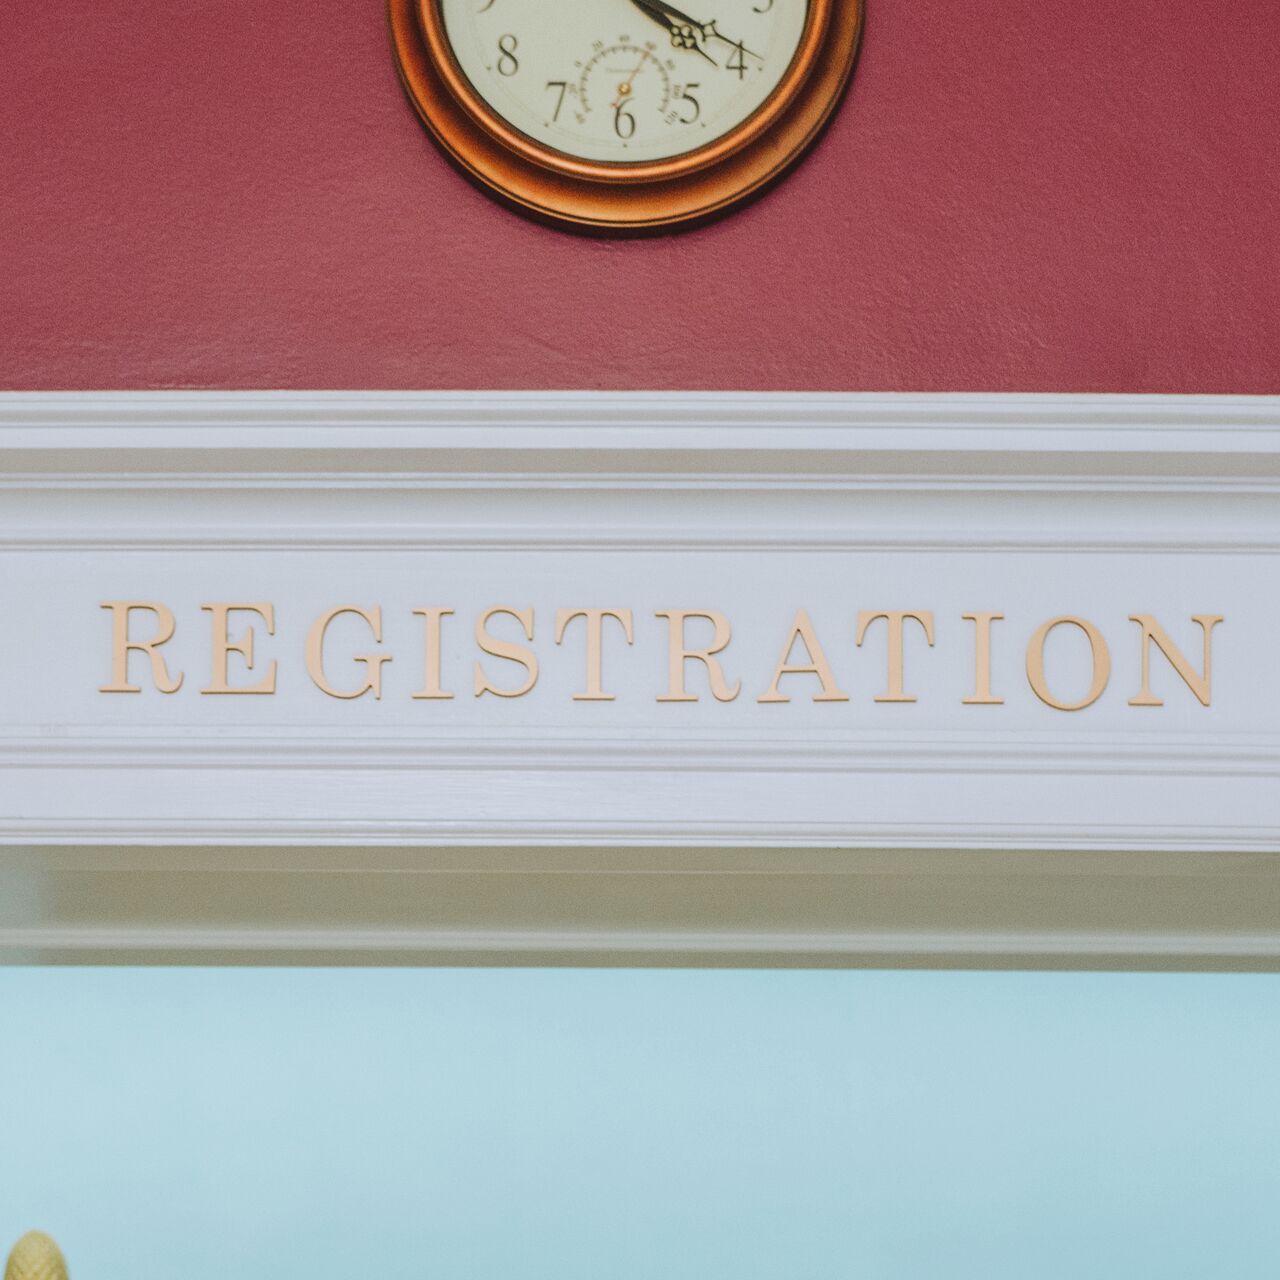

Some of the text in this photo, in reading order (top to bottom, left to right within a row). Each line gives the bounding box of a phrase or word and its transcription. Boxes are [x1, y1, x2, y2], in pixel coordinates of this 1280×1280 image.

[498, 33, 518, 77] 8
[725, 40, 748, 80] 4
[544, 81, 567, 122] 7
[614, 97, 636, 139] 6
[679, 83, 699, 124] 5
[98, 600, 1227, 713] REGISTRATION
